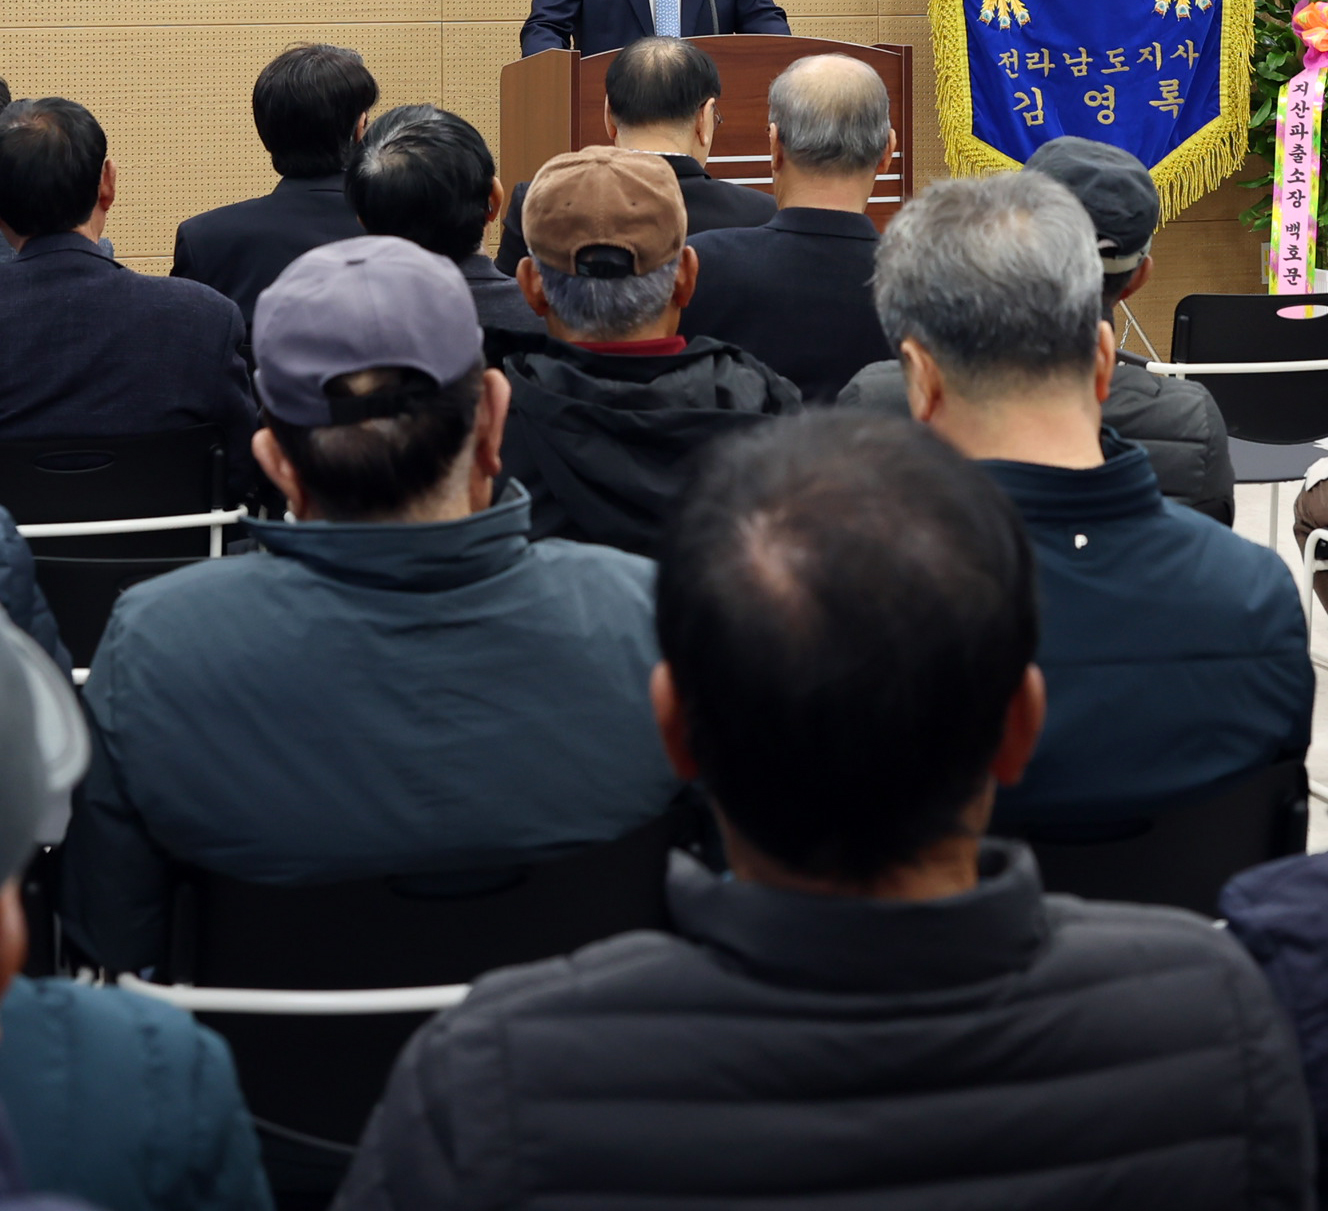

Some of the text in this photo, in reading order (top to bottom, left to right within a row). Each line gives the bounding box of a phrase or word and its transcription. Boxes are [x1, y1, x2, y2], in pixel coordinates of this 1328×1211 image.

[997, 39, 1200, 79] 전라남도지사
[1012, 79, 1186, 127] 김영록
[1282, 80, 1311, 286] 지산파출소장 백호문
